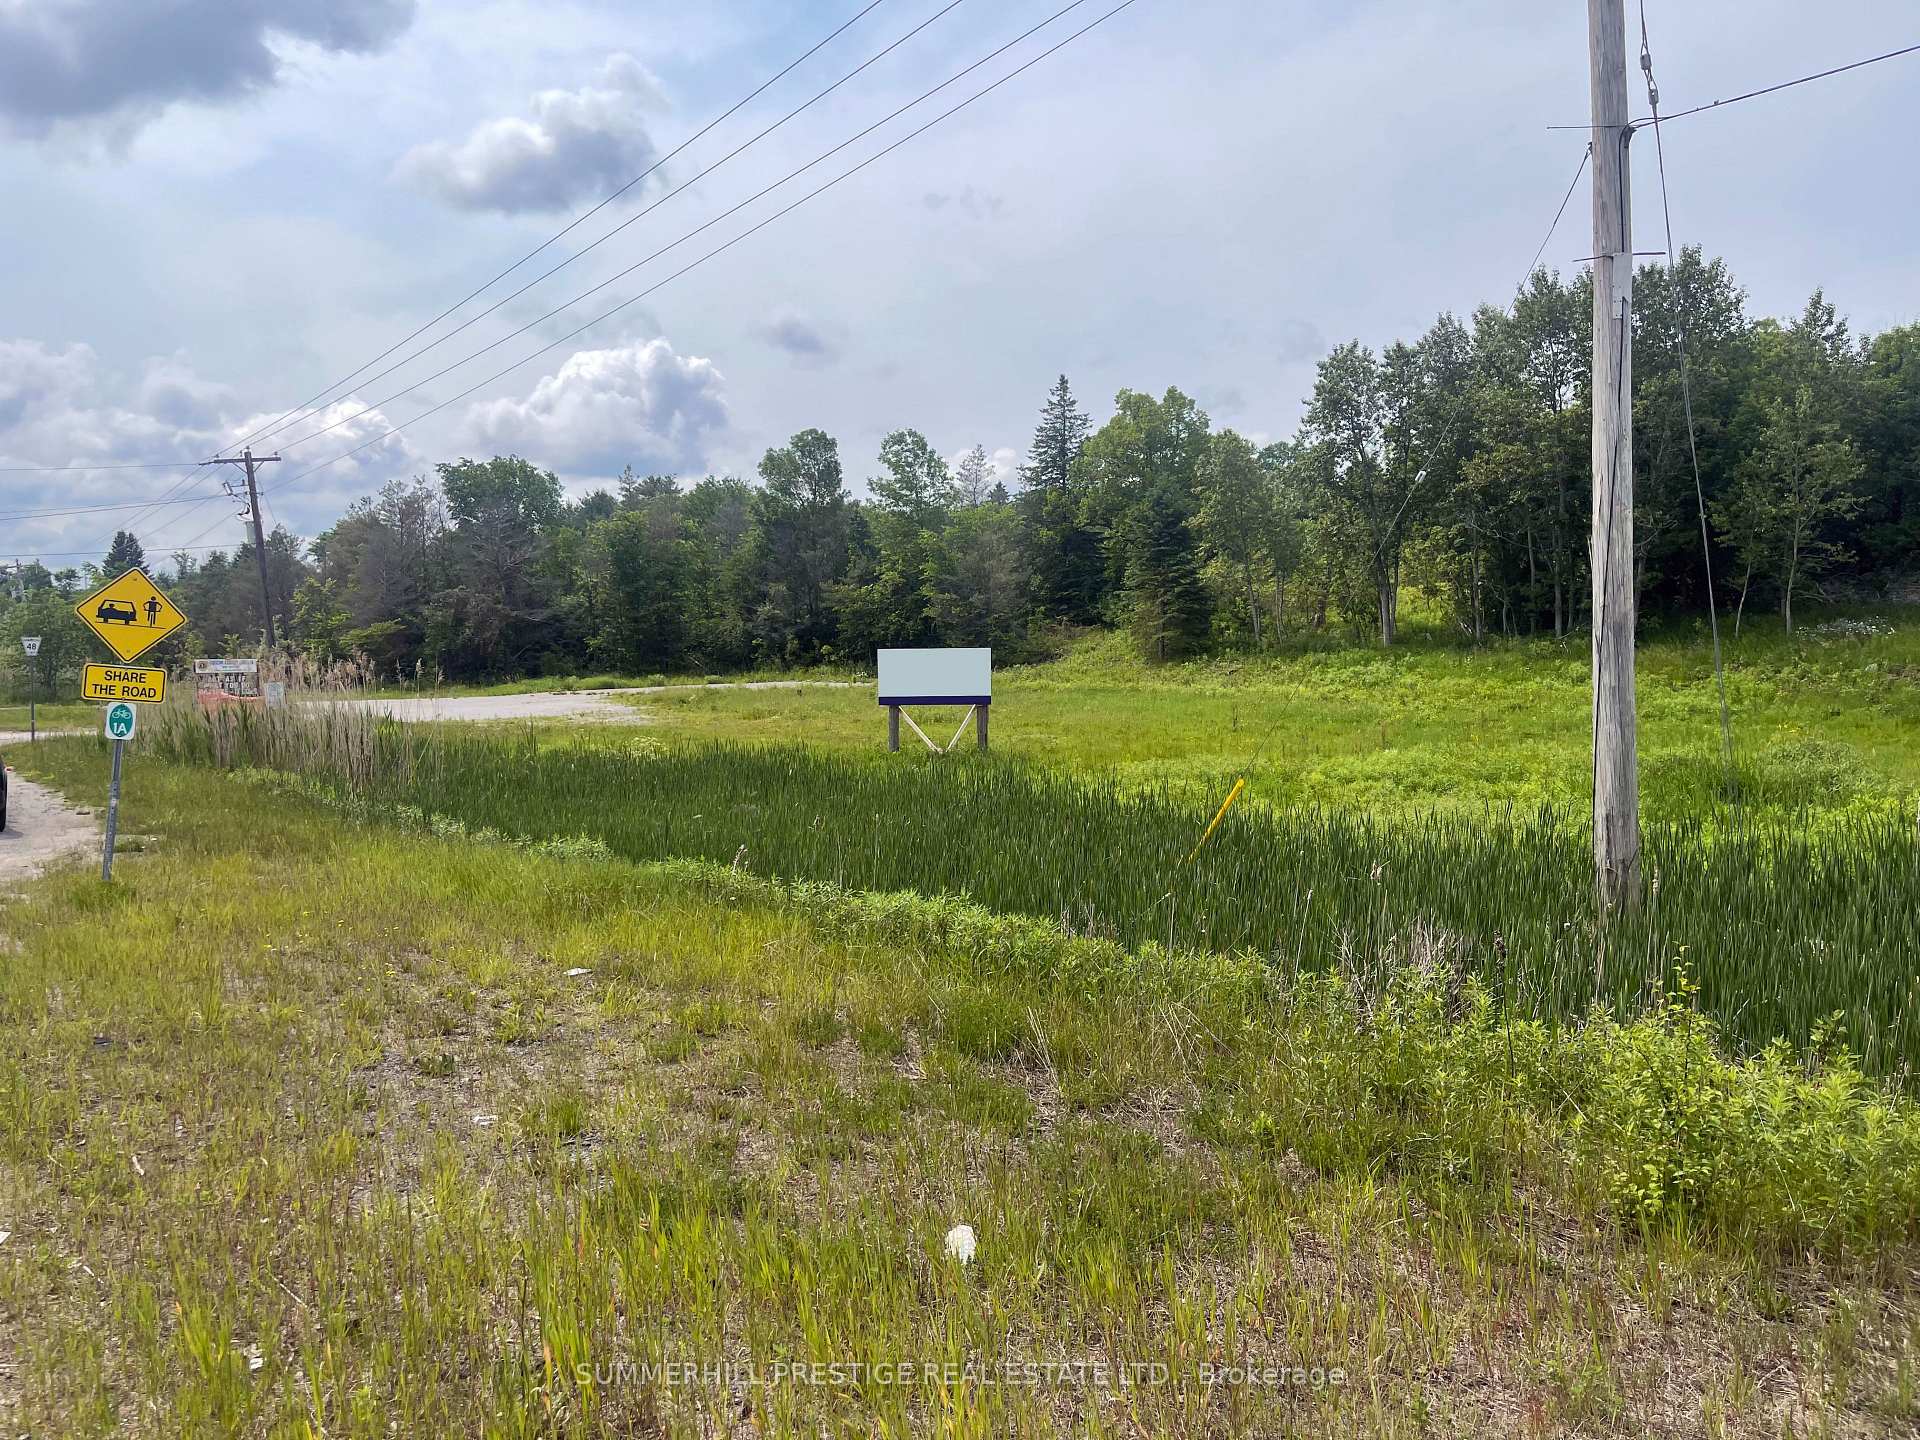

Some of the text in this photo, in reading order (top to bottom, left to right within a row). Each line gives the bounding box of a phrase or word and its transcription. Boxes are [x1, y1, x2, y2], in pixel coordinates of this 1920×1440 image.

[104, 670, 147, 683] SHARE
[92, 684, 157, 698] THE ROAD
[113, 722, 127, 734] 1A
